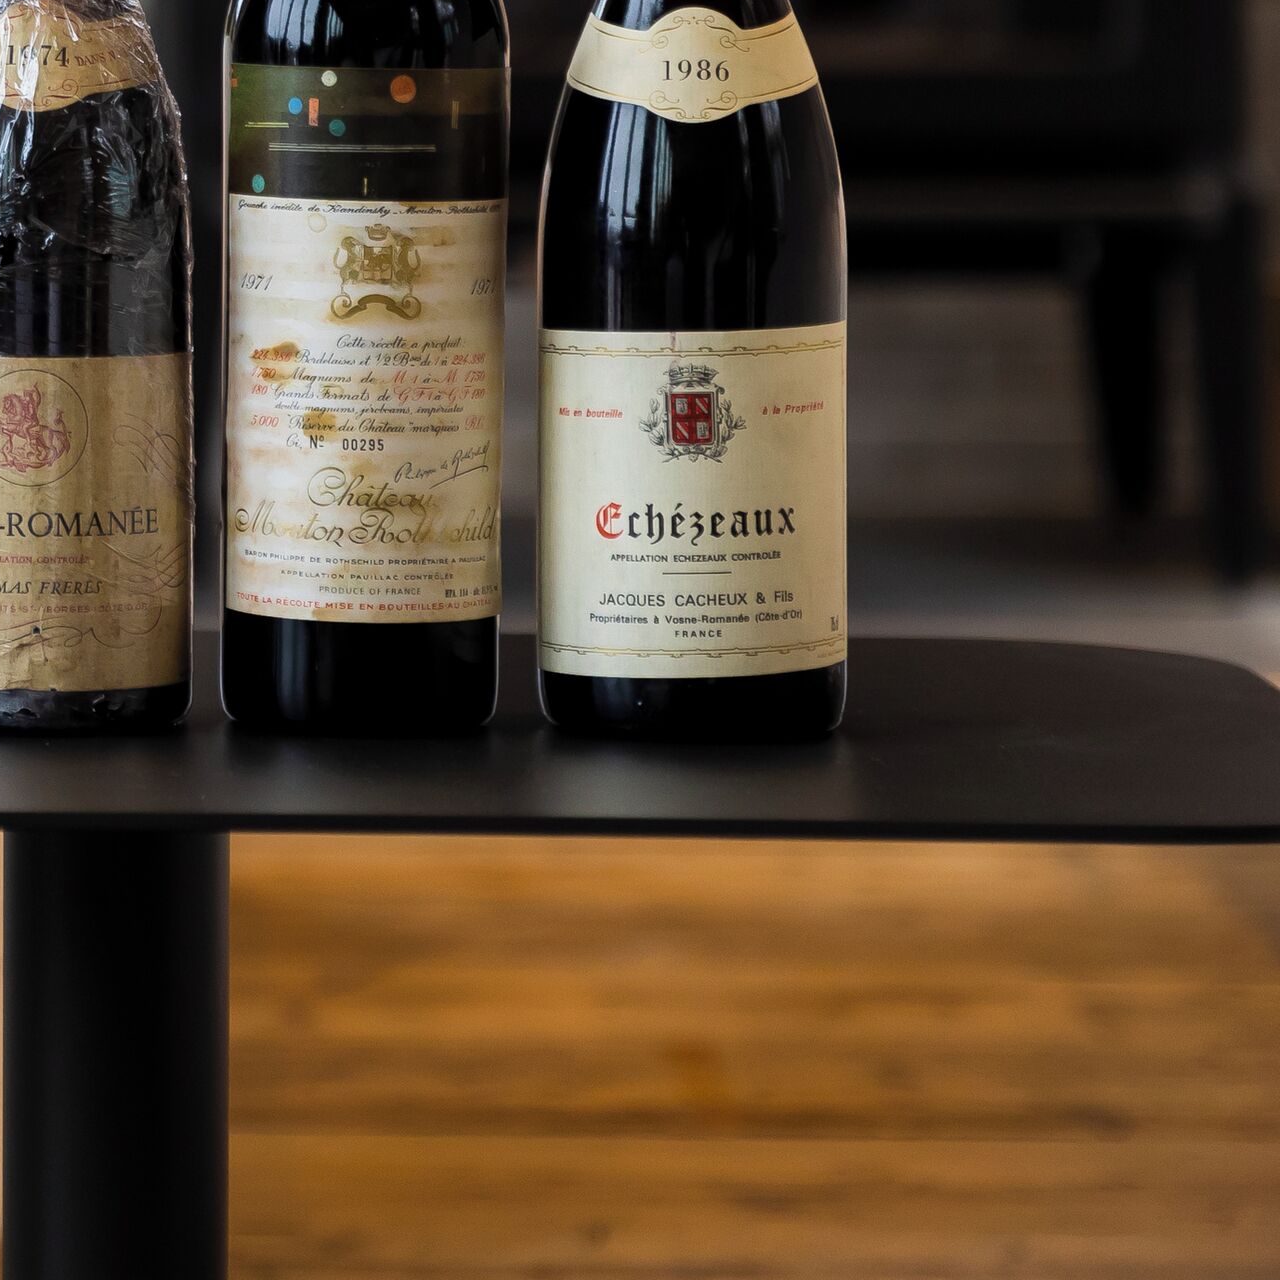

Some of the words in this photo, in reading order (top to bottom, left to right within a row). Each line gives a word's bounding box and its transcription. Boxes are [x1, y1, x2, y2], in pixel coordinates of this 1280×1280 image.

[662, 59, 730, 81] 1986
[308, 204, 321, 212] de
[399, 206, 443, 215] Mouton
[240, 272, 274, 291] 1971
[336, 334, 366, 349] Cette
[295, 349, 356, 366] Bordelaises
[359, 356, 371, 366] et
[283, 367, 352, 391] Magnums
[360, 371, 375, 384] de
[251, 384, 268, 396] 180
[271, 384, 317, 401] Grands
[319, 385, 370, 401] Formats
[377, 389, 391, 401] de
[559, 407, 571, 417] Mis
[586, 408, 624, 418] bouteille
[762, 406, 768, 416] à
[772, 406, 781, 415] la
[784, 400, 825, 414] Propriété
[338, 420, 356, 431] du
[342, 438, 384, 451] 00295
[596, 502, 796, 546] Echézeaux
[244, 549, 268, 559] BARON
[270, 552, 305, 562] PHILIPPE
[326, 557, 385, 566] ROTHSCHILD
[388, 557, 449, 566] PROPRIÉTAIRE
[610, 553, 668, 563] APPELLATION
[673, 553, 727, 563] ECHEZEAUX
[281, 569, 345, 580] APPELLATION
[350, 573, 400, 581] PAUILLAC
[319, 586, 365, 595] PRODUCE
[385, 587, 421, 595] FRANCE
[237, 592, 259, 602] TOUTE
[325, 602, 354, 610] MISE
[359, 602, 374, 611] EN
[379, 601, 444, 611] BOUTEILLES
[599, 593, 666, 607] JACQUES
[675, 593, 748, 606] CACHEUX
[756, 592, 766, 604] &
[774, 590, 794, 603] Fils
[590, 612, 649, 626] Propriétaires
[653, 614, 659, 624] à
[665, 613, 750, 624] Vosne-Romanée
[675, 630, 722, 638] FRANCE
